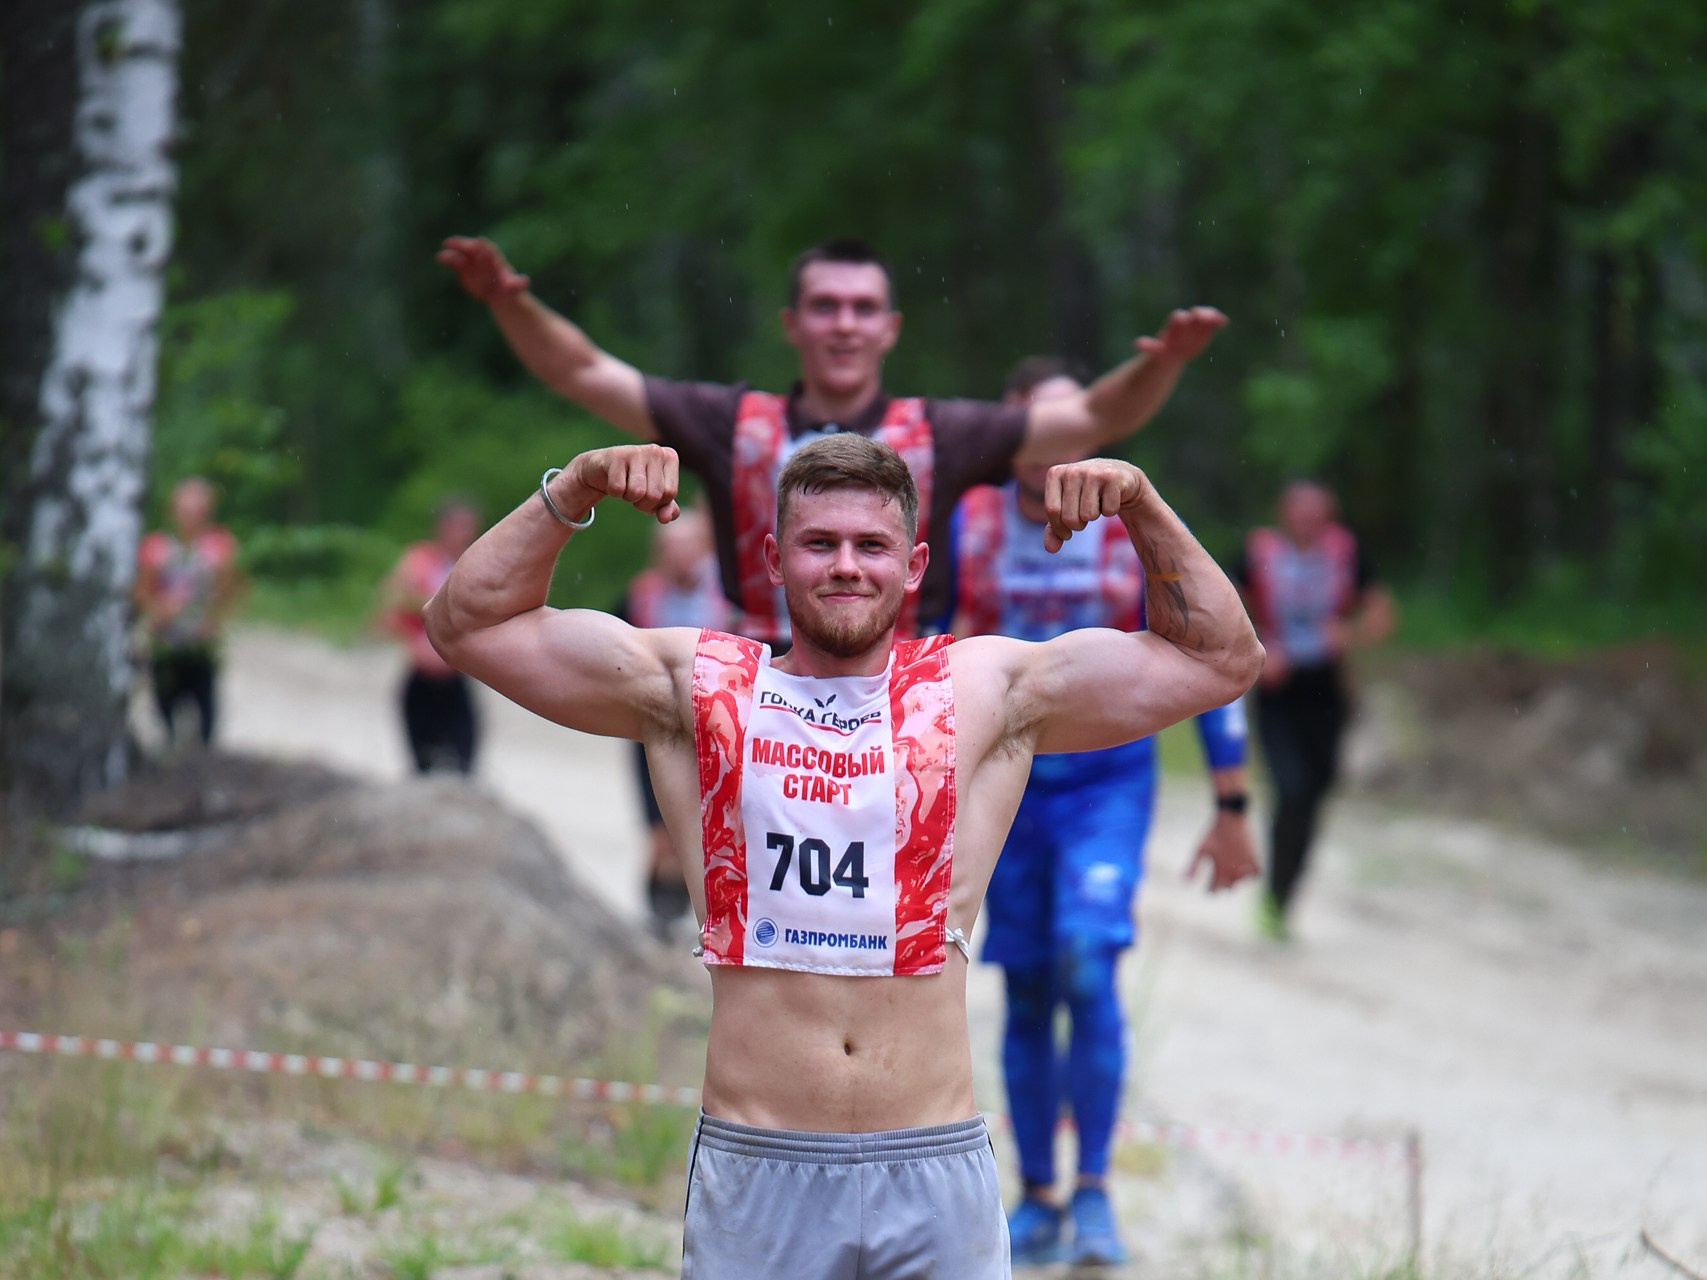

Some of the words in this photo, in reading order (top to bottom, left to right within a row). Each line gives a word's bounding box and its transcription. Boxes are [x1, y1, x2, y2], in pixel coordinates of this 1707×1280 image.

[752, 737, 885, 779] МАССОВЫЙ
[783, 774, 852, 805] СТАРТ
[766, 832, 869, 898] 704
[785, 928, 887, 949] ГАЗПРОМБАНК
